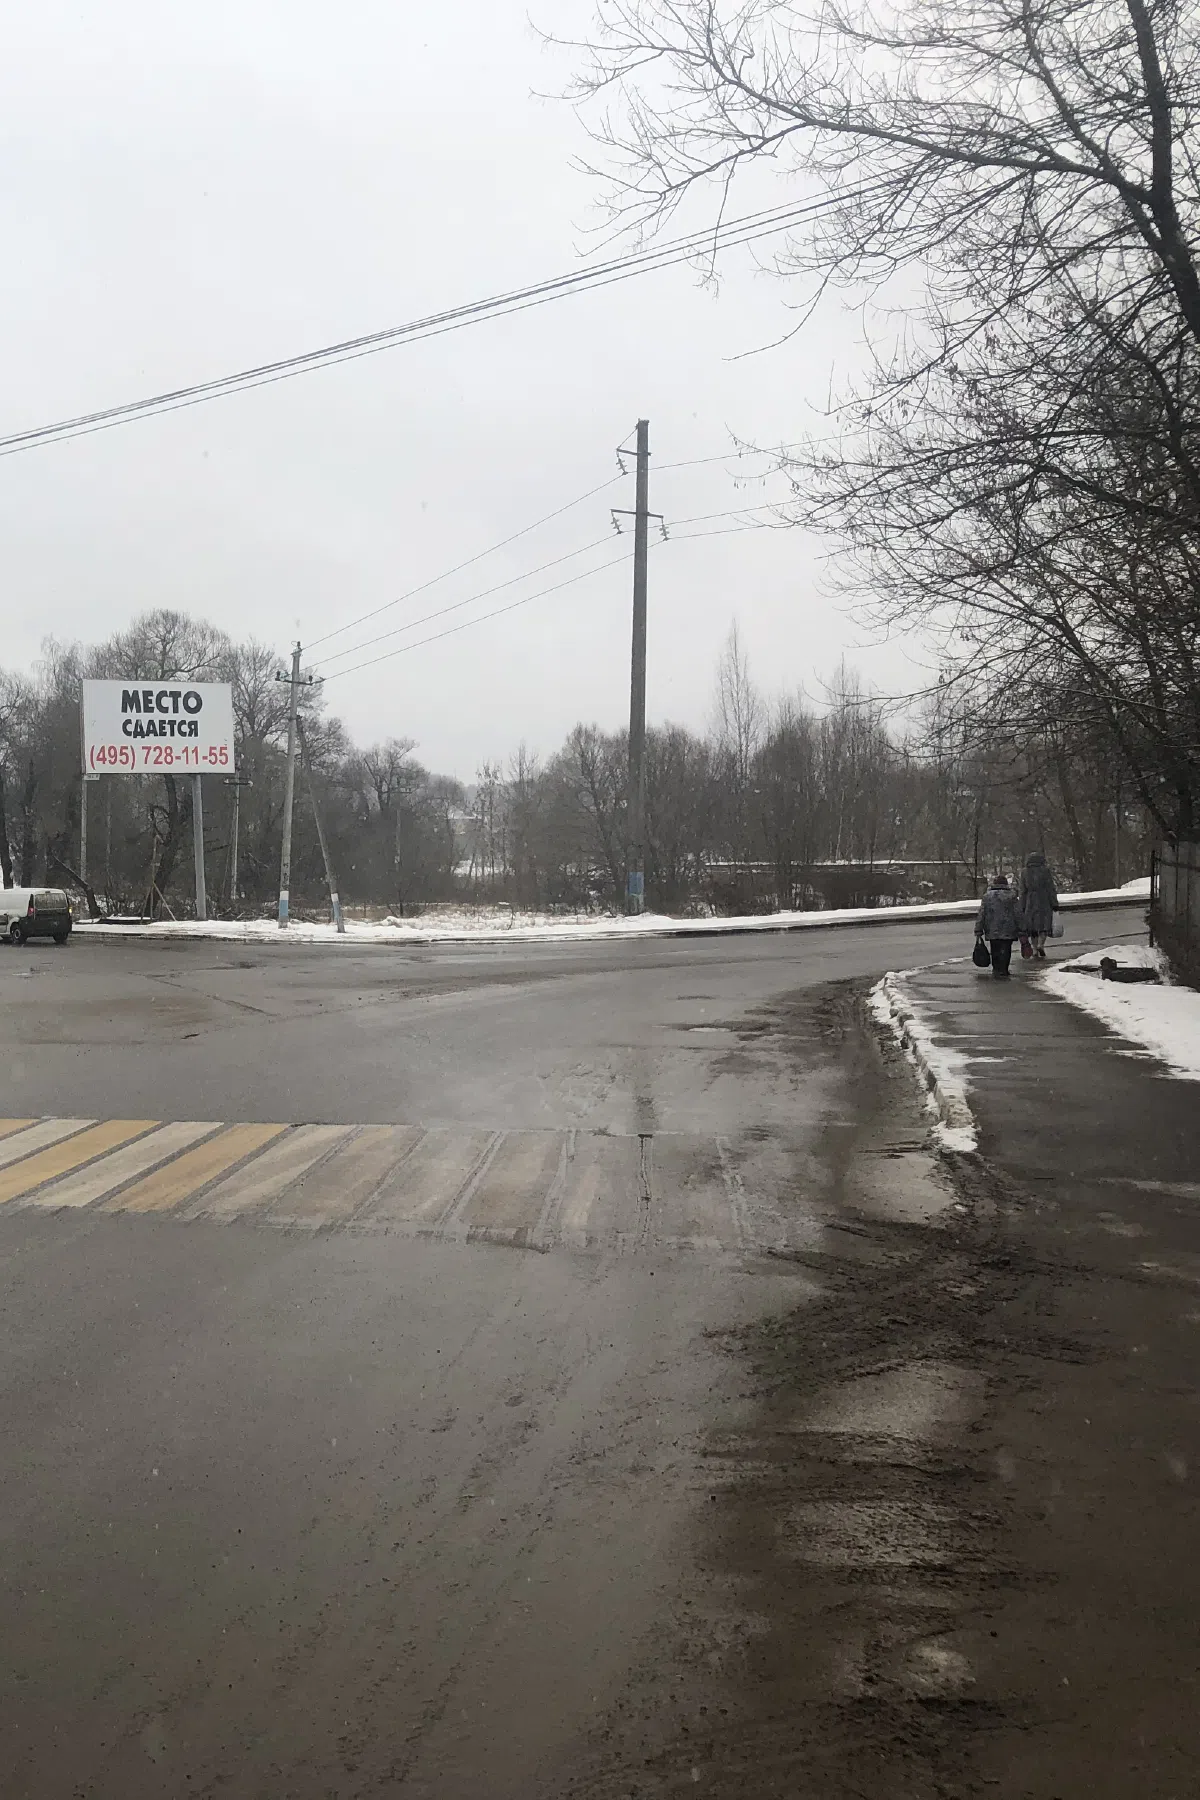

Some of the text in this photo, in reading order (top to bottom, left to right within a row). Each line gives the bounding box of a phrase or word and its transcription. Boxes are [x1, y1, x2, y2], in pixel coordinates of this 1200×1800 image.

[121, 689, 203, 714] МЕСТО
[122, 719, 199, 738] СДАЕТСЯ
[90, 745, 229, 770] (495) 728-11-55
